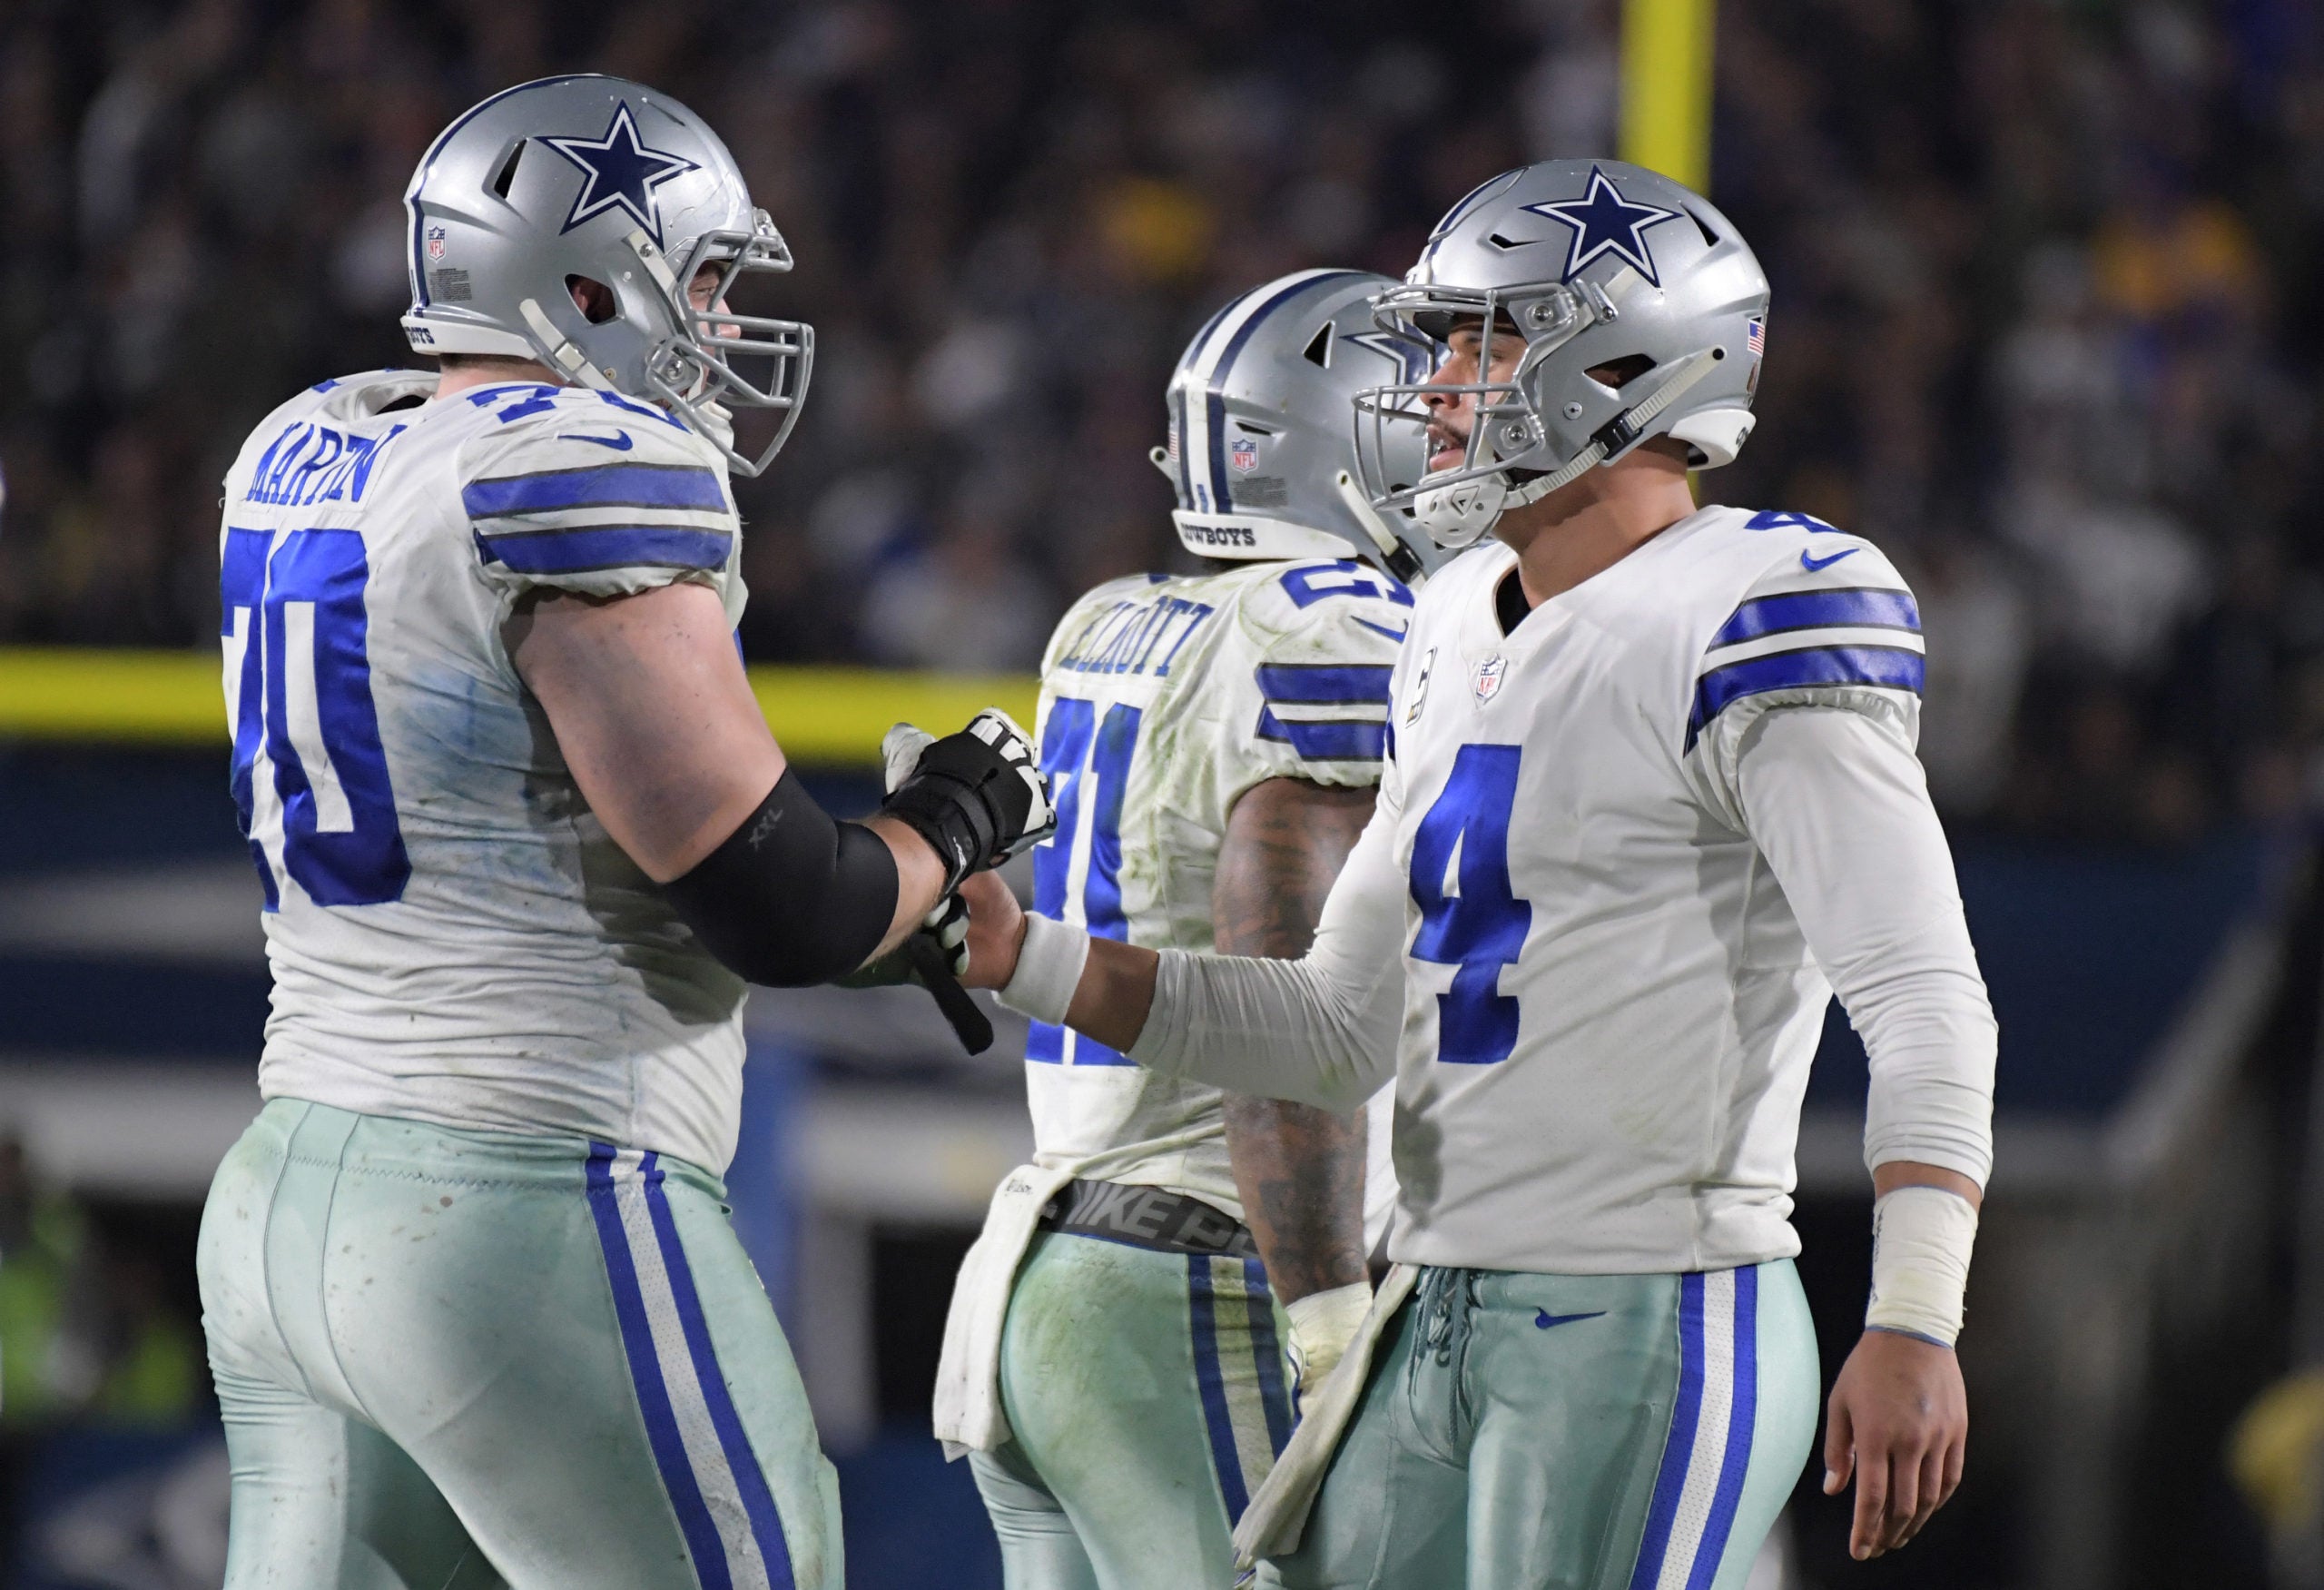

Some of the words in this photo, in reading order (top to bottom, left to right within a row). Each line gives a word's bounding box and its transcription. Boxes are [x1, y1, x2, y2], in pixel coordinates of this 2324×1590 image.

[429, 240, 444, 256] NFL
[404, 326, 435, 344] OYS
[466, 385, 693, 435] 7
[246, 421, 408, 506] MARTIN
[1235, 452, 1255, 469] NFL
[1181, 522, 1256, 547] OWBOYS
[221, 527, 412, 914] 70
[1409, 744, 1532, 1064] 4
